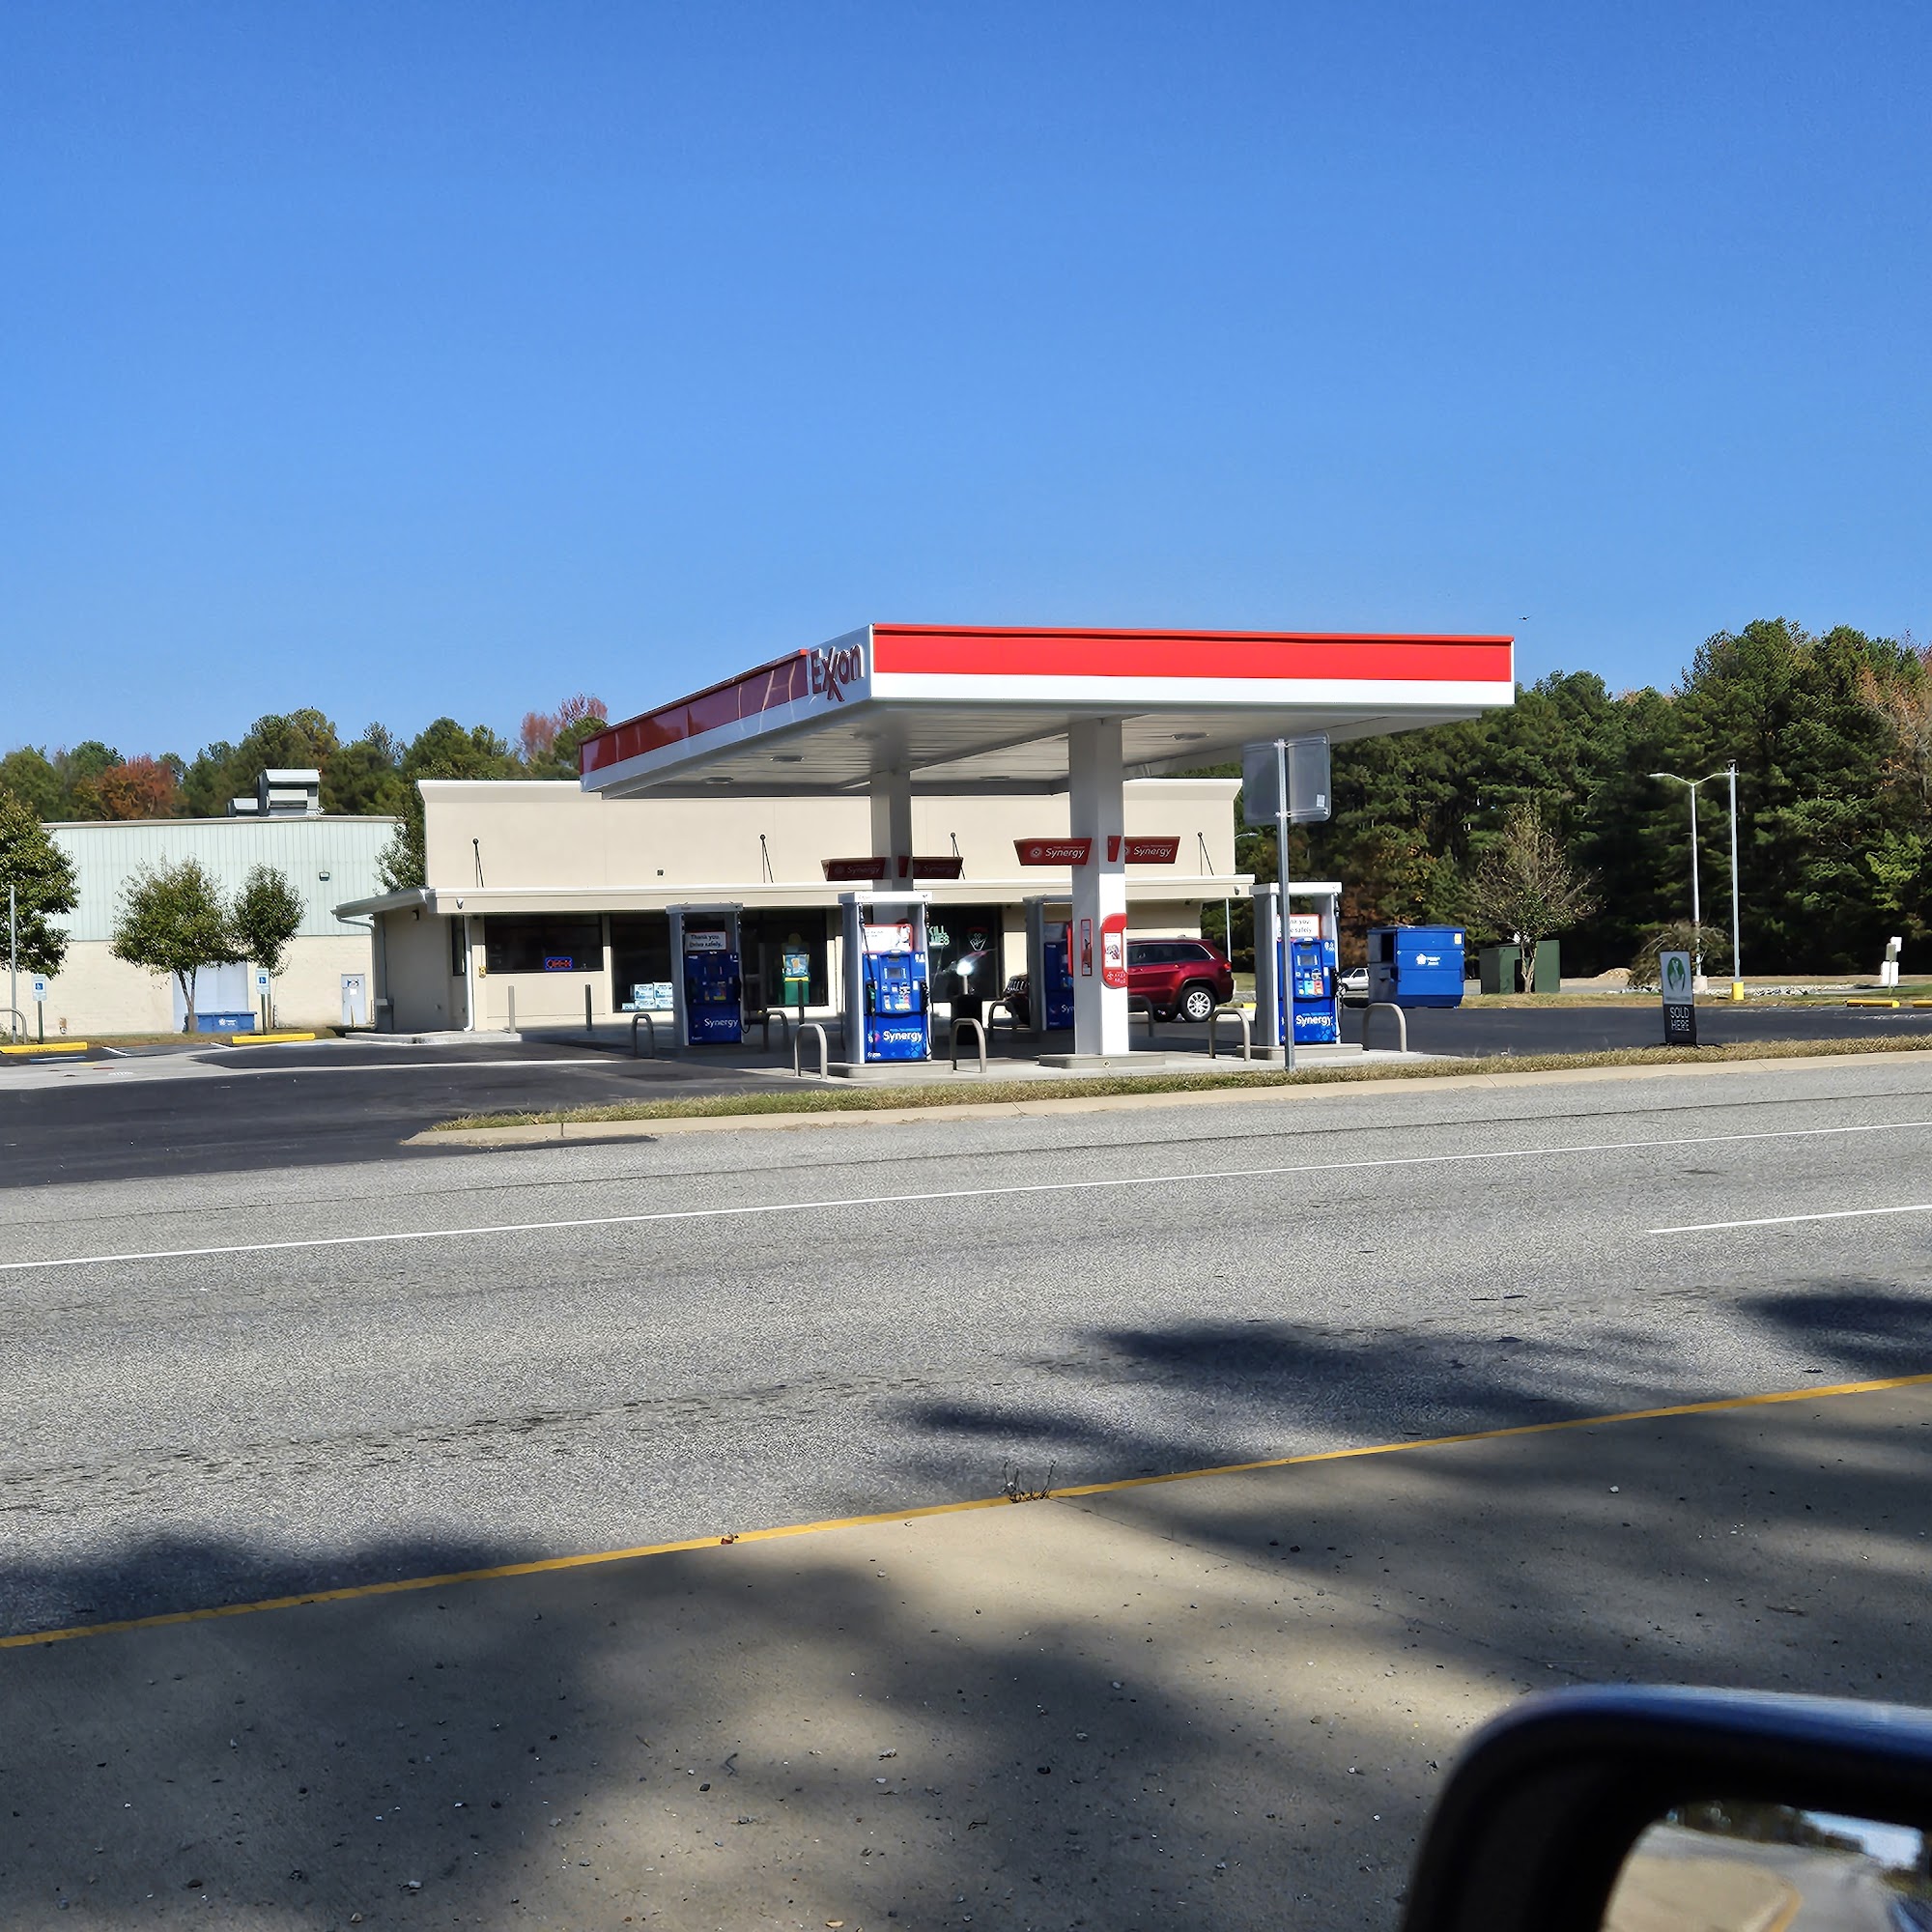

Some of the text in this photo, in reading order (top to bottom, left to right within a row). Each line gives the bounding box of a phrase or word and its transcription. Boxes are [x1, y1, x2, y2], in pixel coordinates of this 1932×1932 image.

[810, 644, 865, 701] Exxon
[1045, 847, 1085, 859] Synergy
[1133, 846, 1173, 858] Synergy
[847, 866, 881, 874] Synergy
[1669, 1007, 1690, 1019] SOLD
[704, 1017, 738, 1028] Synergy
[1295, 1014, 1333, 1028] Synergy
[883, 1030, 923, 1043] Synergy
